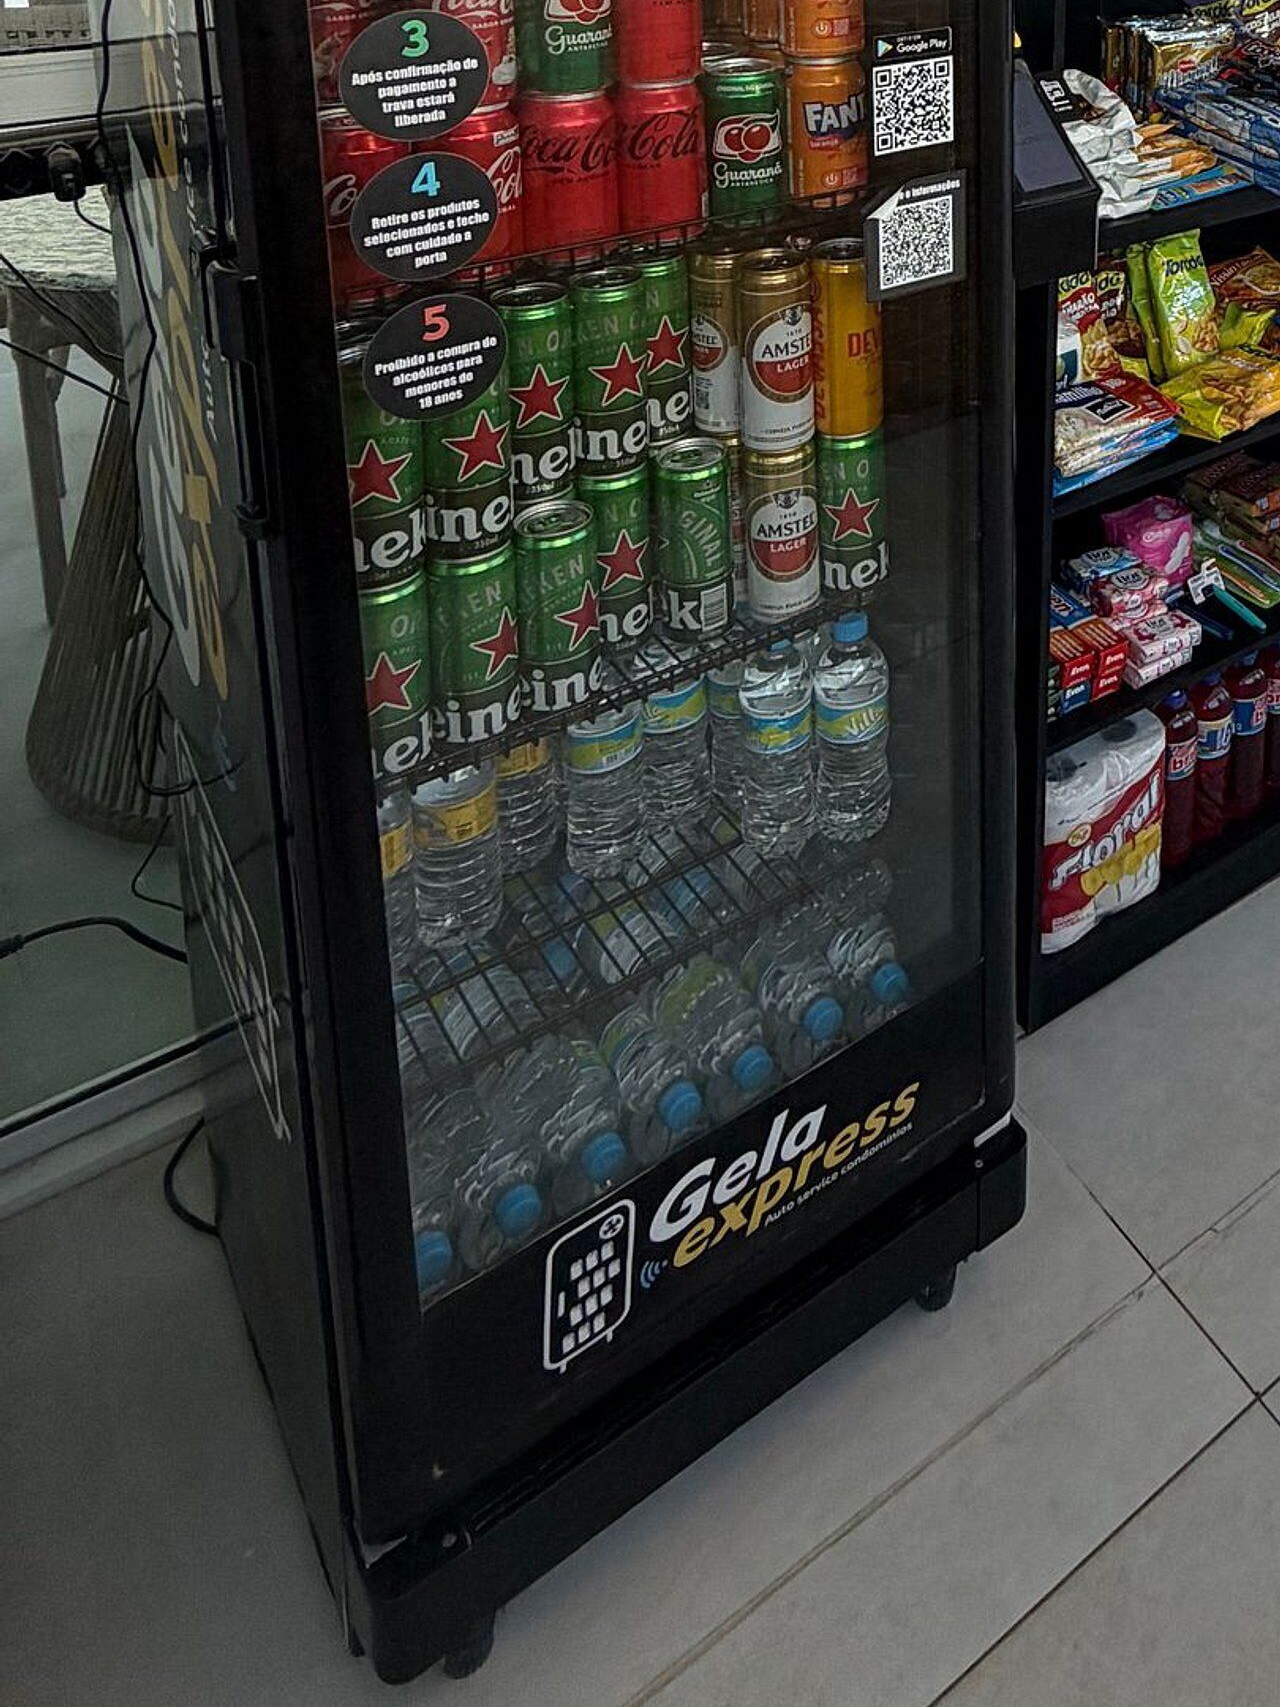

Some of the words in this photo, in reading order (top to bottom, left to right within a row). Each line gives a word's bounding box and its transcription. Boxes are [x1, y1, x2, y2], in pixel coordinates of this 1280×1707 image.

[401, 19, 430, 59] 3
[896, 41, 928, 54] Google
[929, 37, 948, 49] Play
[351, 70, 384, 87] Após
[384, 60, 462, 82] confirmação
[463, 58, 479, 71] de
[378, 80, 448, 100] pagamento
[449, 76, 457, 88] a
[382, 98, 416, 114] trava
[416, 91, 455, 109] estará
[803, 91, 866, 134] FANT
[394, 109, 447, 129] liberada
[411, 161, 441, 197] 4
[713, 162, 783, 190] Guaraná
[364, 221, 446, 247] selecionados
[447, 218, 455, 230] e
[456, 211, 490, 228] feche
[371, 214, 409, 230] Retire
[410, 210, 426, 223] os
[427, 198, 480, 220] produtos
[386, 243, 413, 258] com
[414, 233, 462, 252] cuidado
[464, 231, 472, 241] a
[414, 251, 447, 270] porta
[422, 303, 450, 342] 5
[374, 354, 425, 376] Proibido
[427, 352, 436, 364] a
[437, 340, 482, 361] compra
[482, 336, 498, 349] de
[392, 362, 455, 387] alcoólicos
[456, 354, 483, 370] para
[404, 376, 458, 398] menores
[459, 371, 474, 384] de
[418, 395, 432, 410] 18
[434, 389, 463, 406] anos
[124, 123, 201, 687] Gela
[770, 537, 807, 553] LAGER
[1051, 770, 1160, 891] Floral
[649, 1104, 829, 1244] Gela
[673, 1082, 920, 1269] express
[764, 1201, 796, 1228] Auto
[797, 1169, 839, 1210] service
